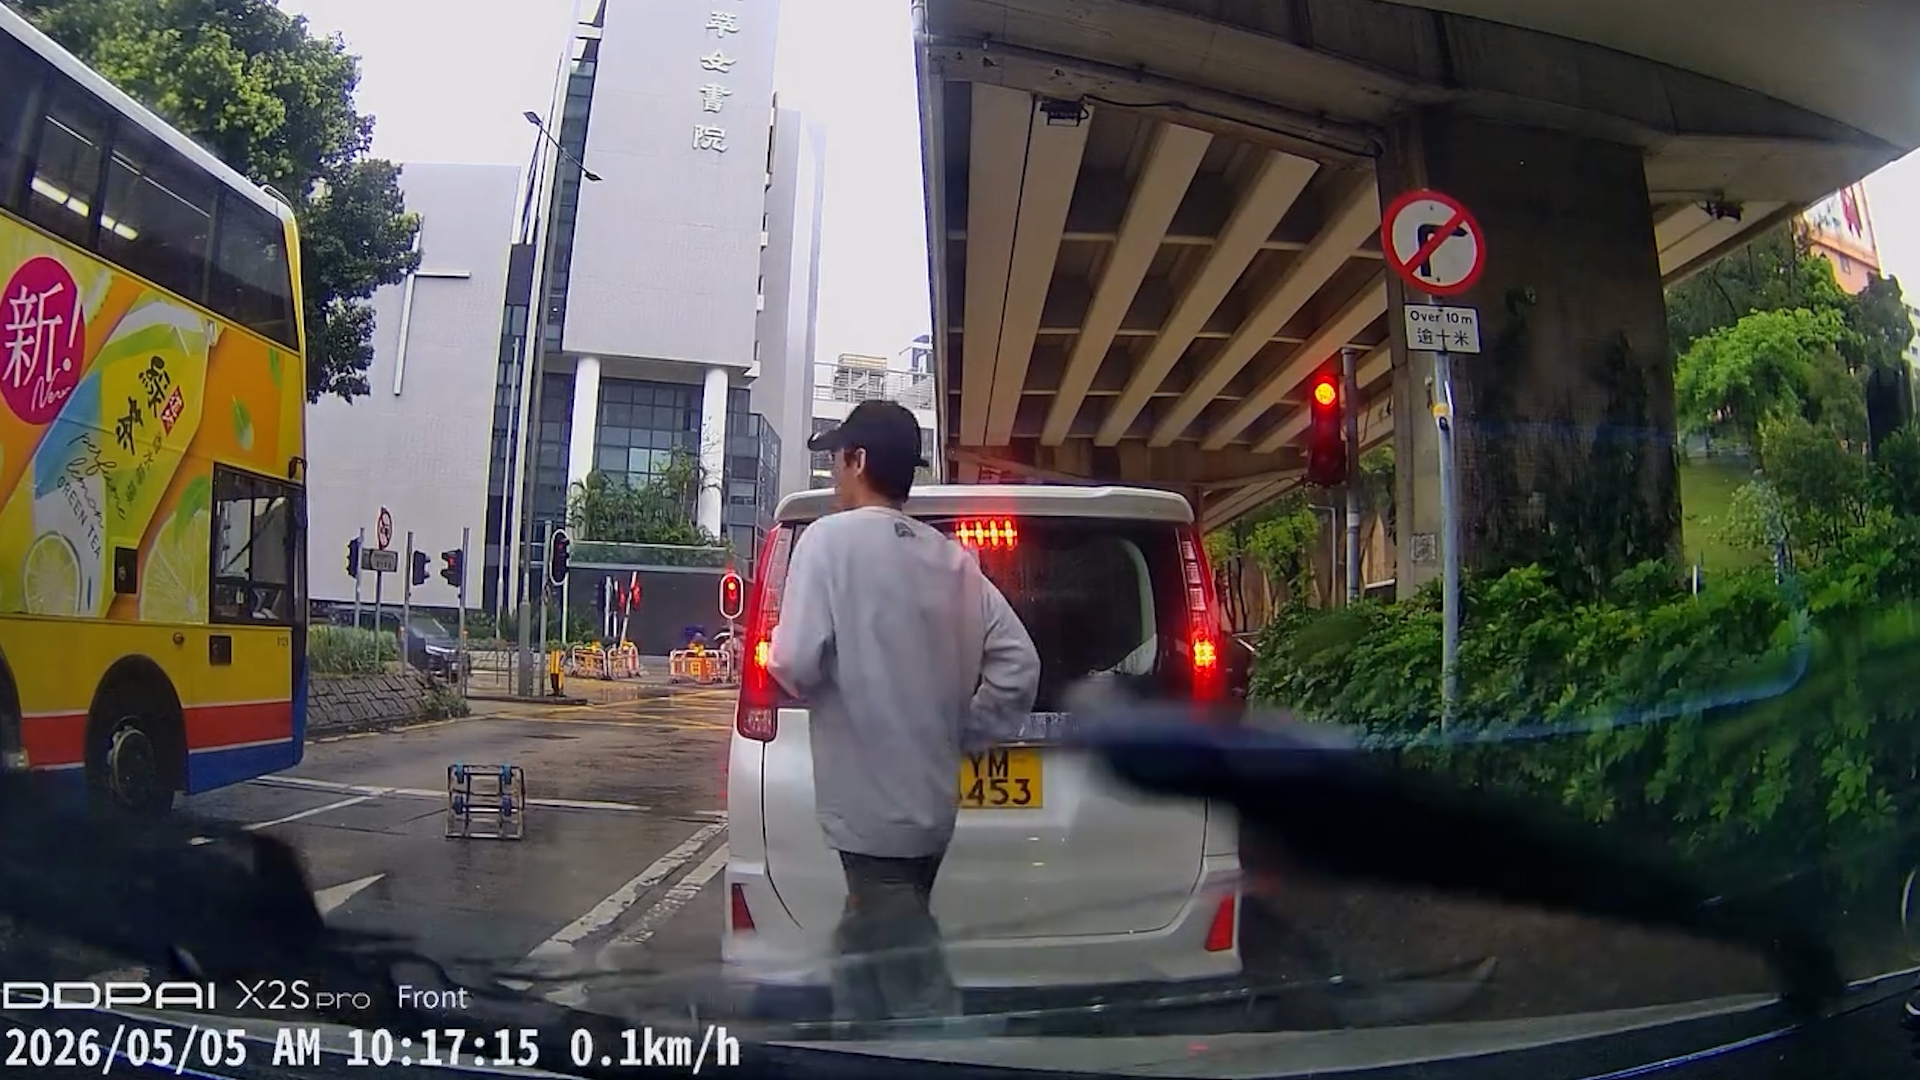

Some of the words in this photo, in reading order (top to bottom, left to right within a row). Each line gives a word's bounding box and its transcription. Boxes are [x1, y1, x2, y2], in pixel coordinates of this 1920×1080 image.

[692, 0, 743, 153] 華女書院
[1410, 310, 1440, 323] Over
[1417, 327, 1469, 347] 逾十米
[57, 475, 89, 527] GREEN
[87, 524, 101, 560] TEA
[968, 748, 1009, 778] YM
[957, 778, 1031, 806] 453
